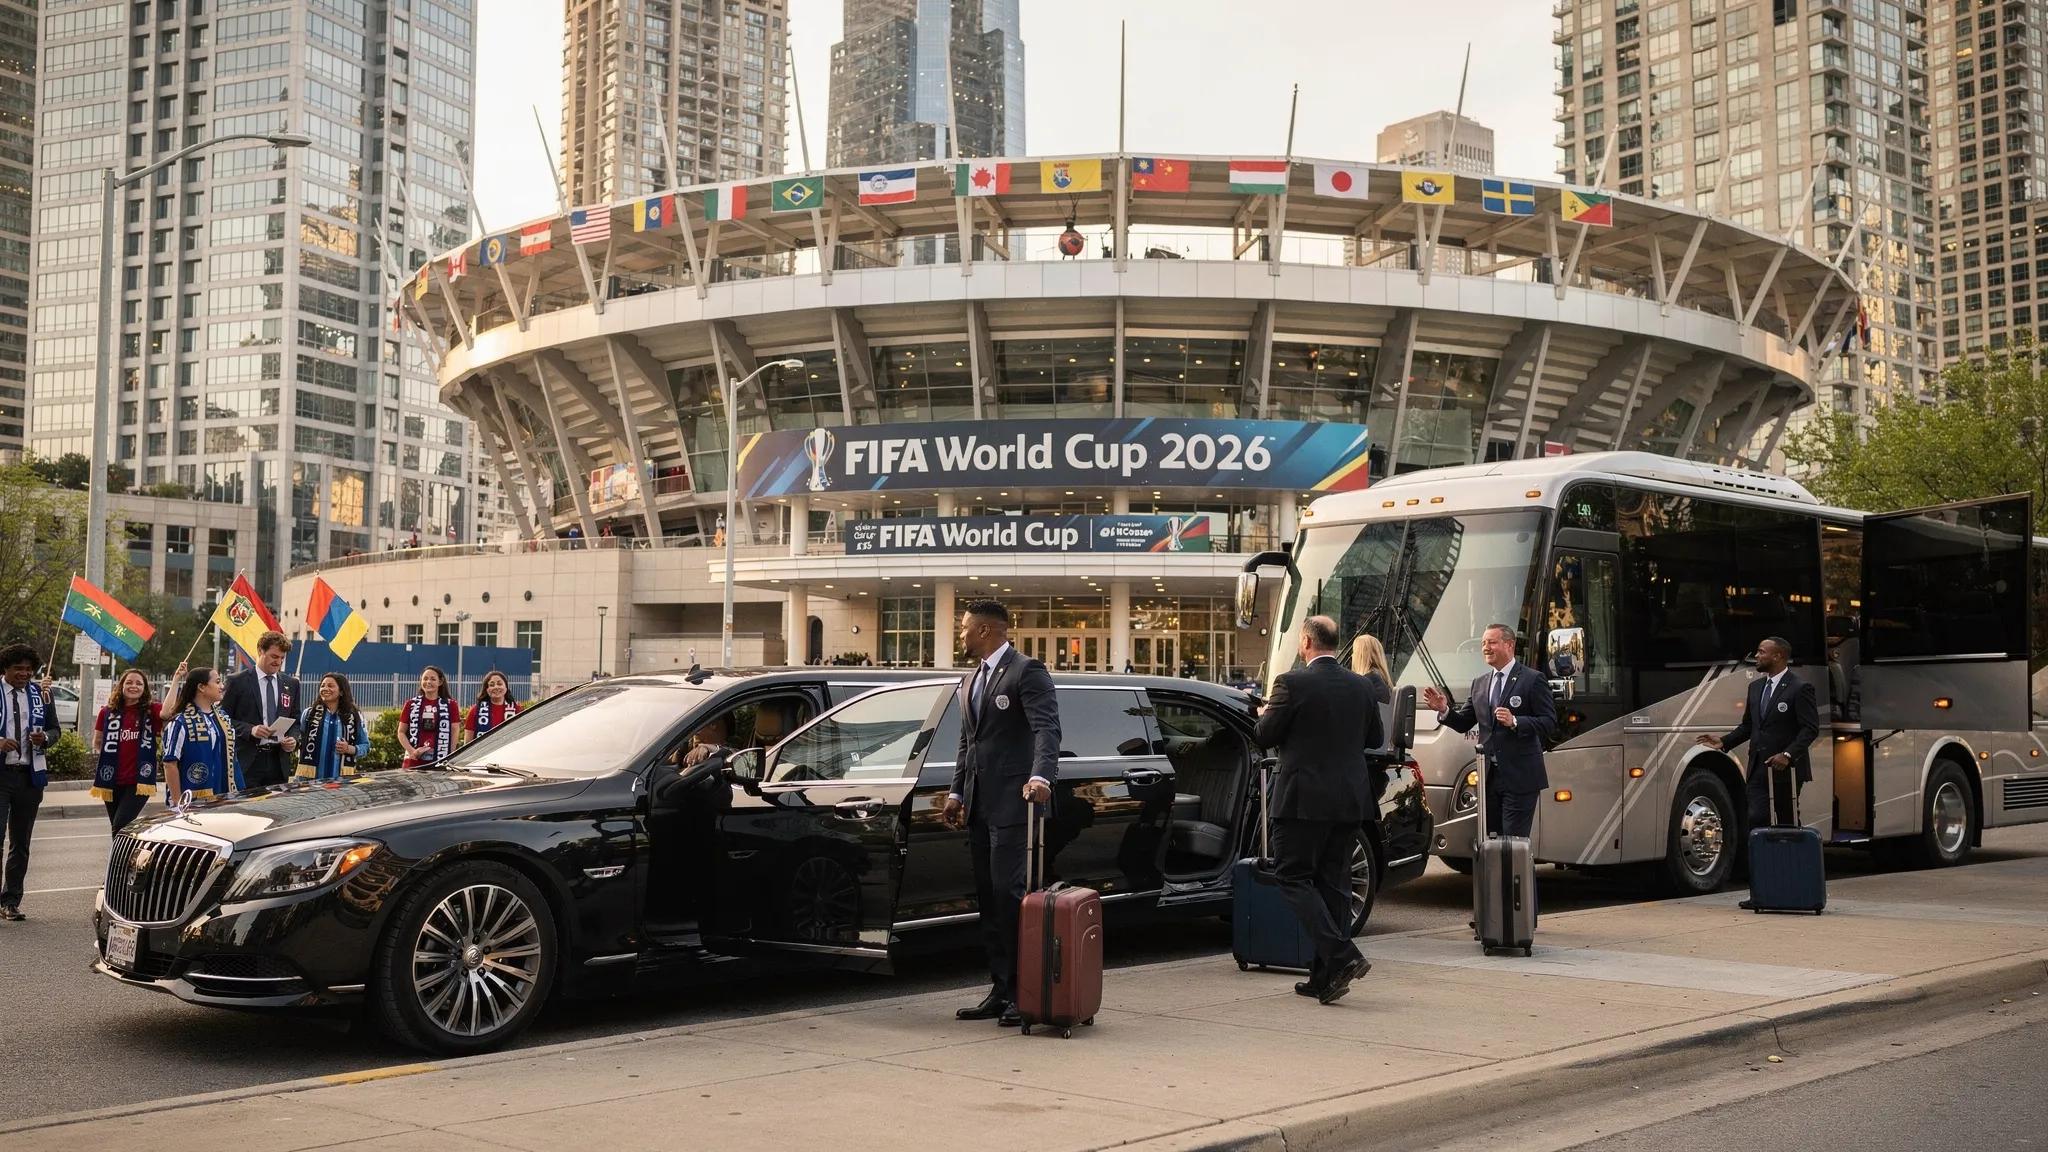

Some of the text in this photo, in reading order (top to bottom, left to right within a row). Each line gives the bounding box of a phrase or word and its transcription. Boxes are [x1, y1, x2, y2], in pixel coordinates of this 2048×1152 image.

[845, 432, 1271, 477] FIFA World Cup 2026
[879, 524, 937, 548] FIFA
[941, 522, 1017, 546] World
[1024, 522, 1079, 550] Cup
